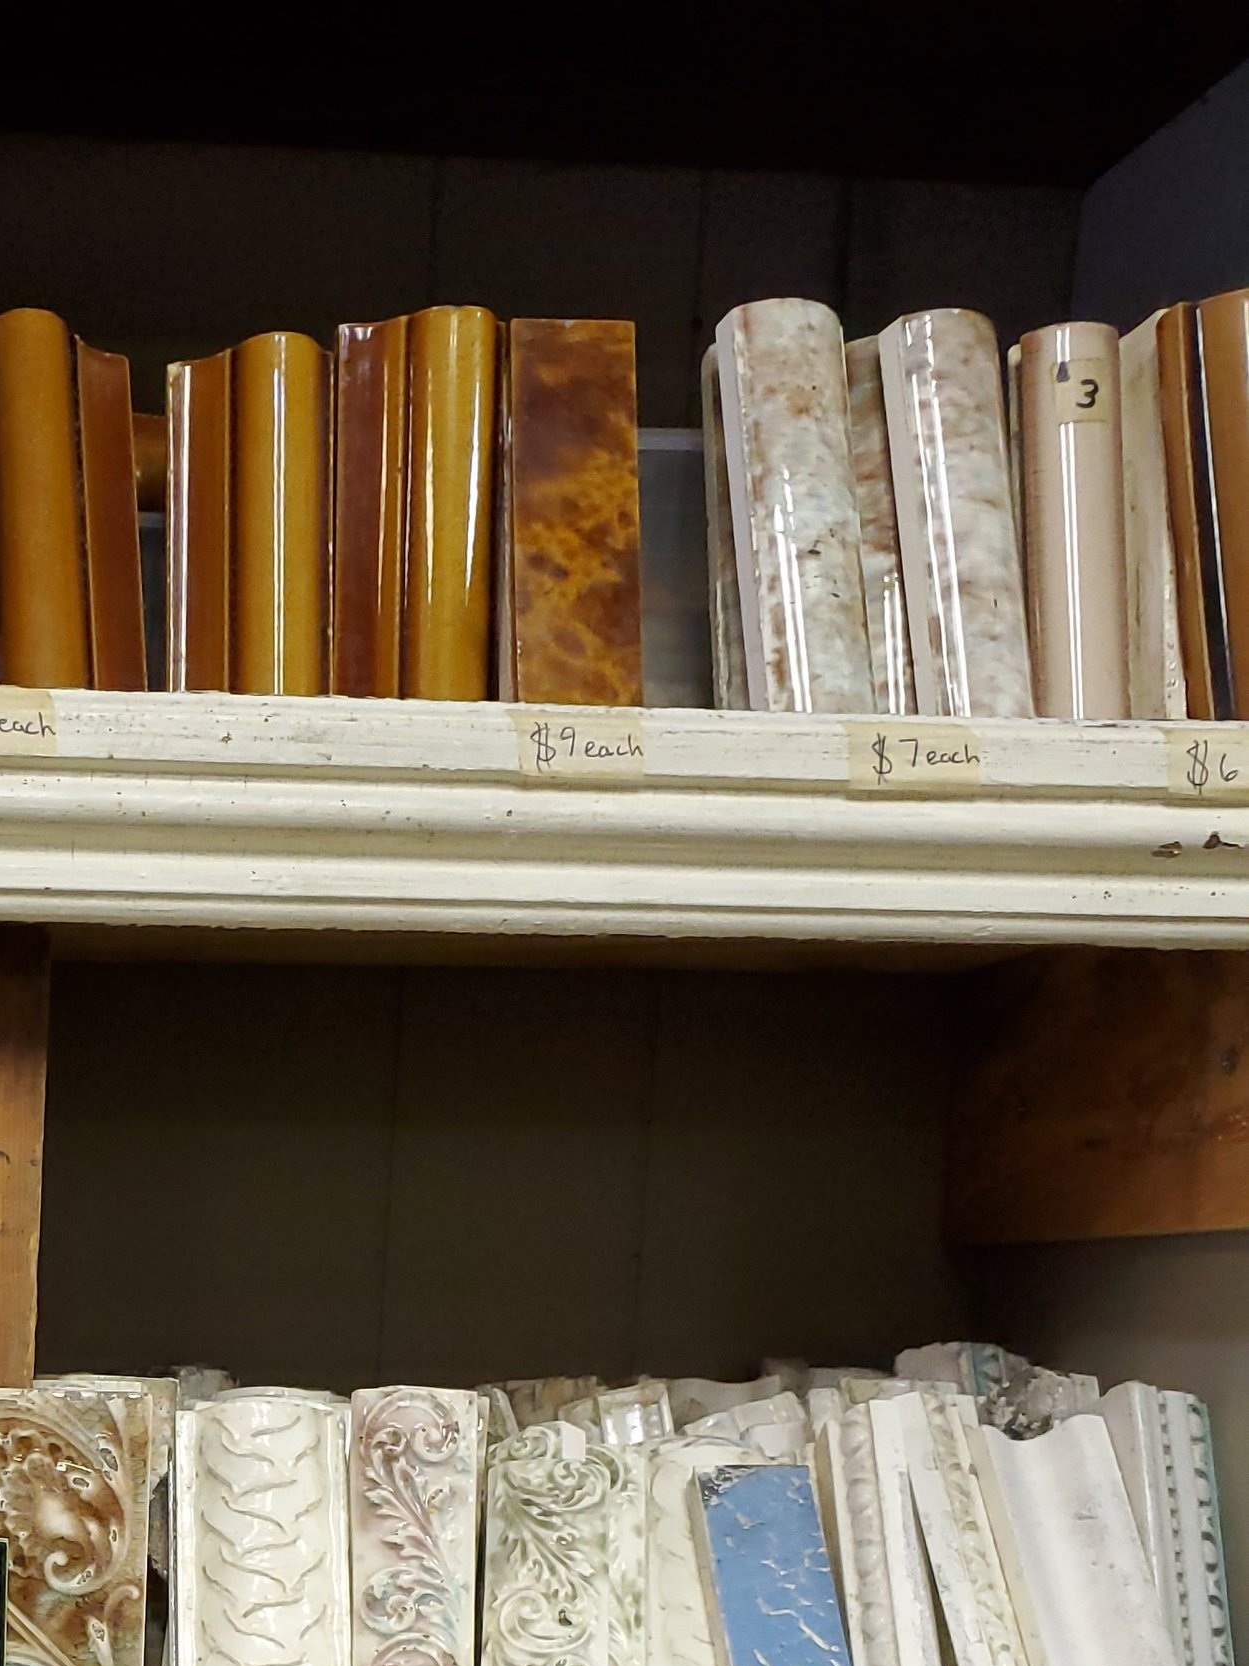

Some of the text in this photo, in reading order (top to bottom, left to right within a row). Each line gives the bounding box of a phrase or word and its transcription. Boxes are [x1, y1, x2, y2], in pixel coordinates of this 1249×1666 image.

[1075, 378, 1100, 409] 3
[530, 722, 644, 773] $9 each
[871, 733, 981, 785] $7 each
[1186, 740, 1238, 795] $6
